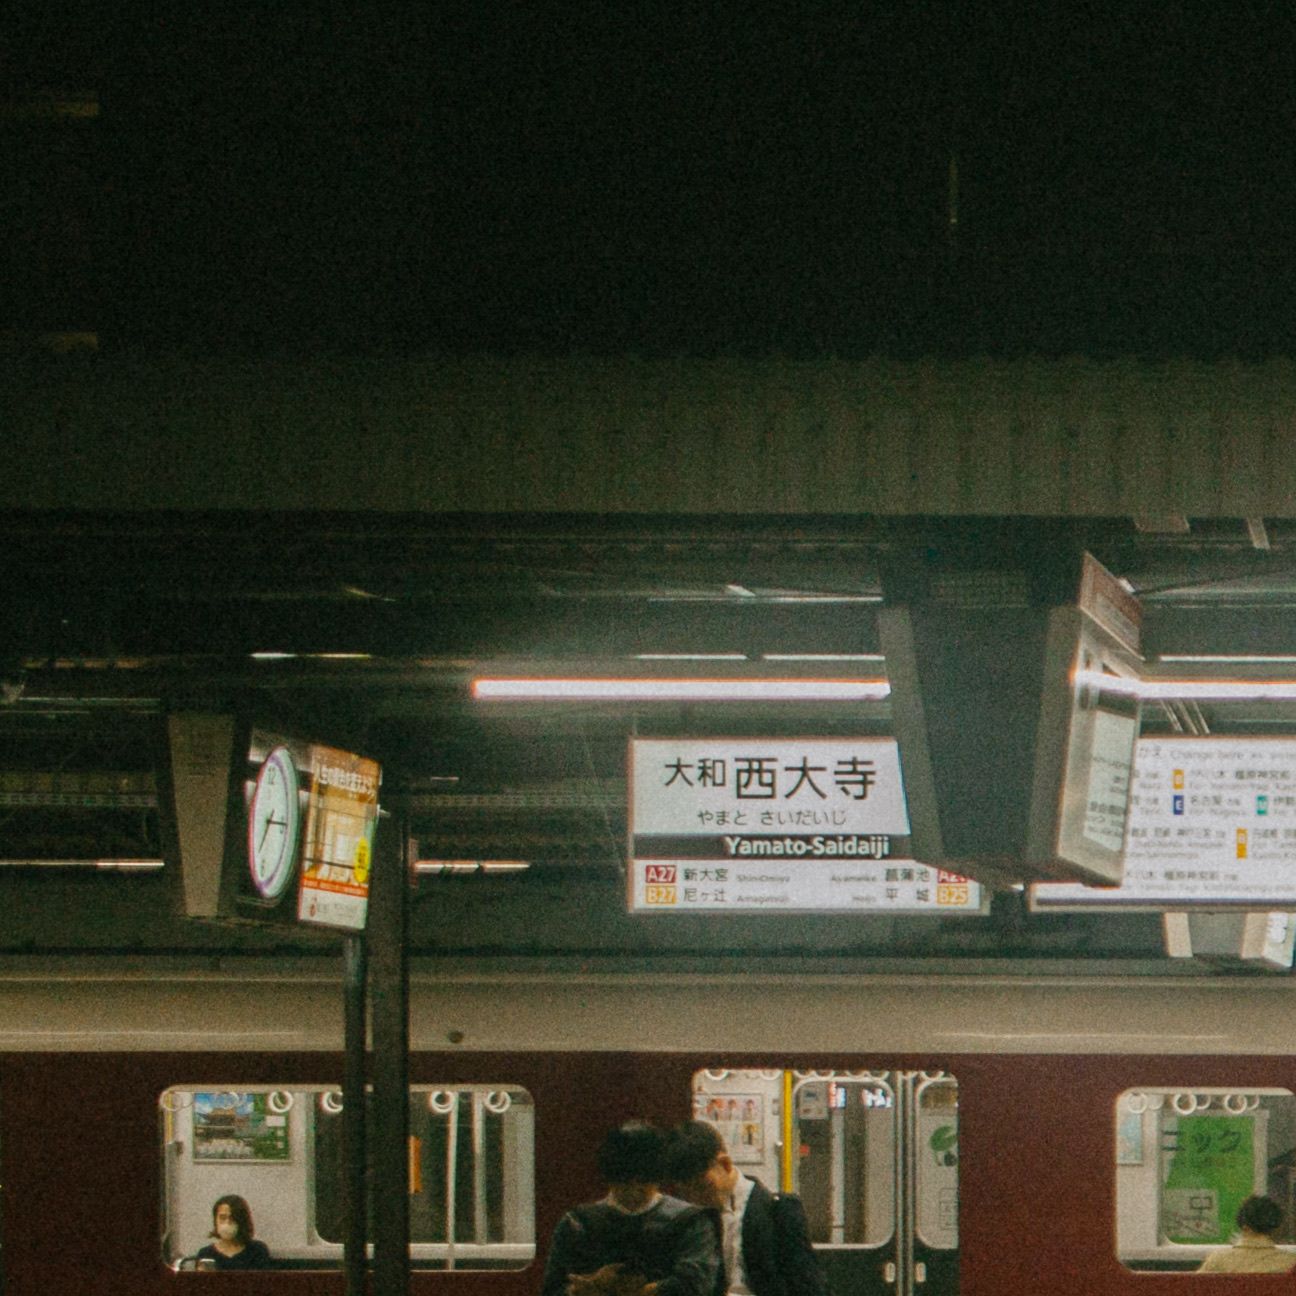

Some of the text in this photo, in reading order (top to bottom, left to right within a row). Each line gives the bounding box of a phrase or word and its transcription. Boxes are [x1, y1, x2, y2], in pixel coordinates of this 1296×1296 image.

[664, 756, 877, 800] 大和西大寺
[697, 810, 846, 827] やまと さいだいじ
[726, 836, 889, 858] Yamato-Saidaiji
[647, 866, 675, 882] A27
[683, 867, 729, 882] 新大宮
[647, 886, 676, 903] B27
[938, 887, 968, 904] B25
